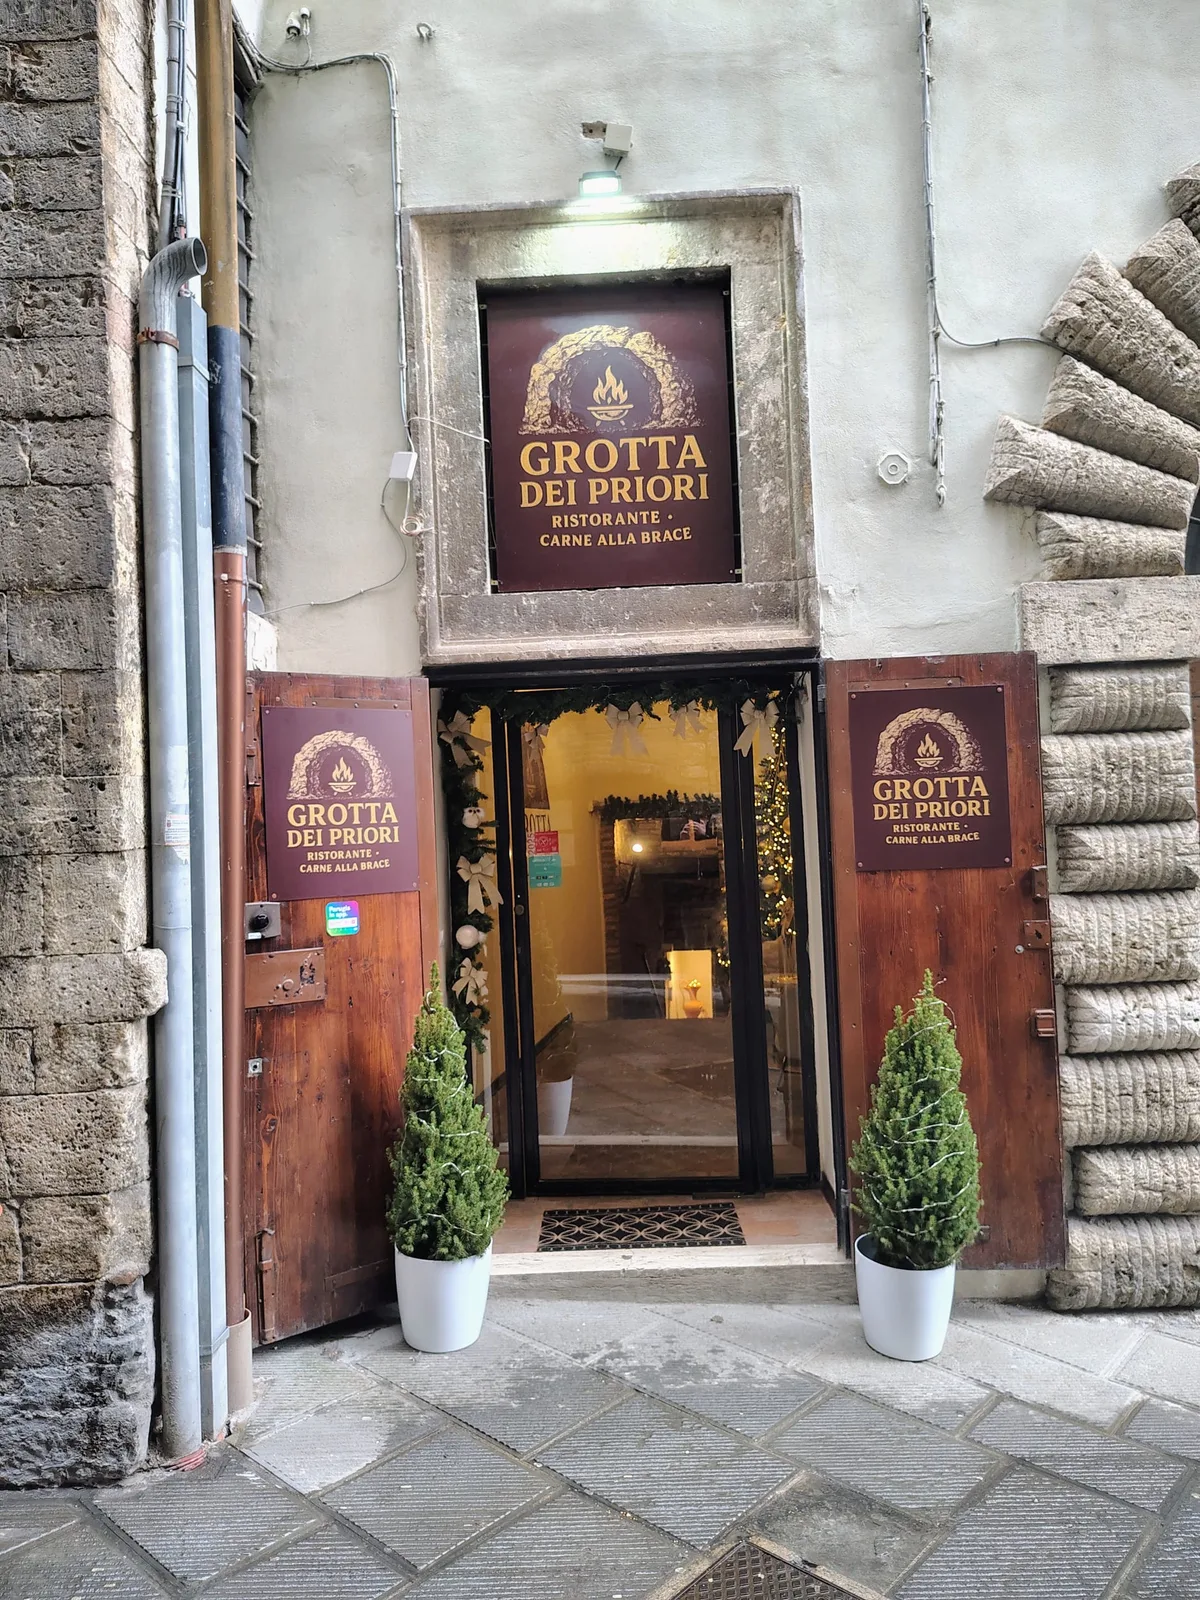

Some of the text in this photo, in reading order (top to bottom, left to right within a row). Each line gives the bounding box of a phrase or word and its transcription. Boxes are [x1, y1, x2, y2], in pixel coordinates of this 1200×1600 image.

[520, 434, 707, 475] GROTTA
[520, 474, 708, 507] DEI PRIORI
[552, 511, 660, 527] RISTORANTE
[540, 527, 691, 546] CARNE ALLA BRACE
[873, 776, 989, 801] GROTTA
[287, 802, 399, 827] GROTTA
[873, 800, 990, 820] DEI PRIORI
[287, 826, 399, 847] DEI PRIORI
[893, 822, 960, 832] RISTORANTE
[886, 836, 918, 844] CARNE
[948, 832, 979, 842] BRACE
[308, 849, 372, 860] RISTORANTE
[300, 859, 390, 872] CARNE ALLA BRACE
